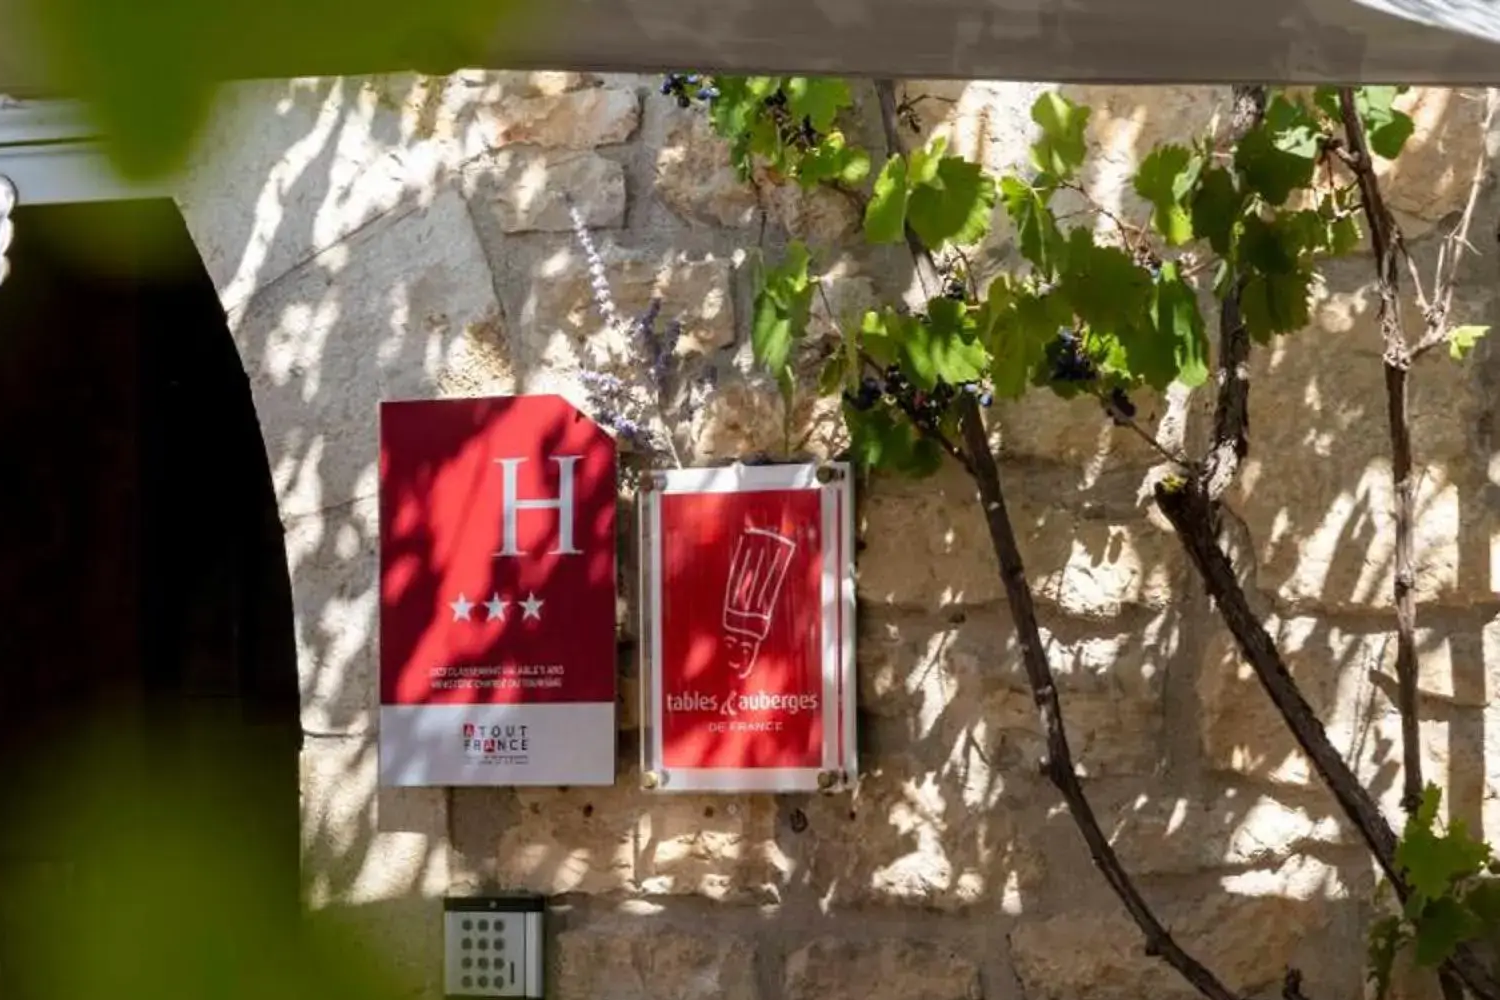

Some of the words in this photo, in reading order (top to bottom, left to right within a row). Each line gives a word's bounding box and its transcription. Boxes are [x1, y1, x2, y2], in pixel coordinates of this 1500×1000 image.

[491, 454, 585, 557] H
[666, 690, 717, 711] tables
[738, 689, 818, 715] auberges
[463, 724, 528, 738] ATOUT
[708, 721, 725, 732] DE
[728, 721, 784, 732] FRANCE
[464, 739, 529, 752] FRANCE
